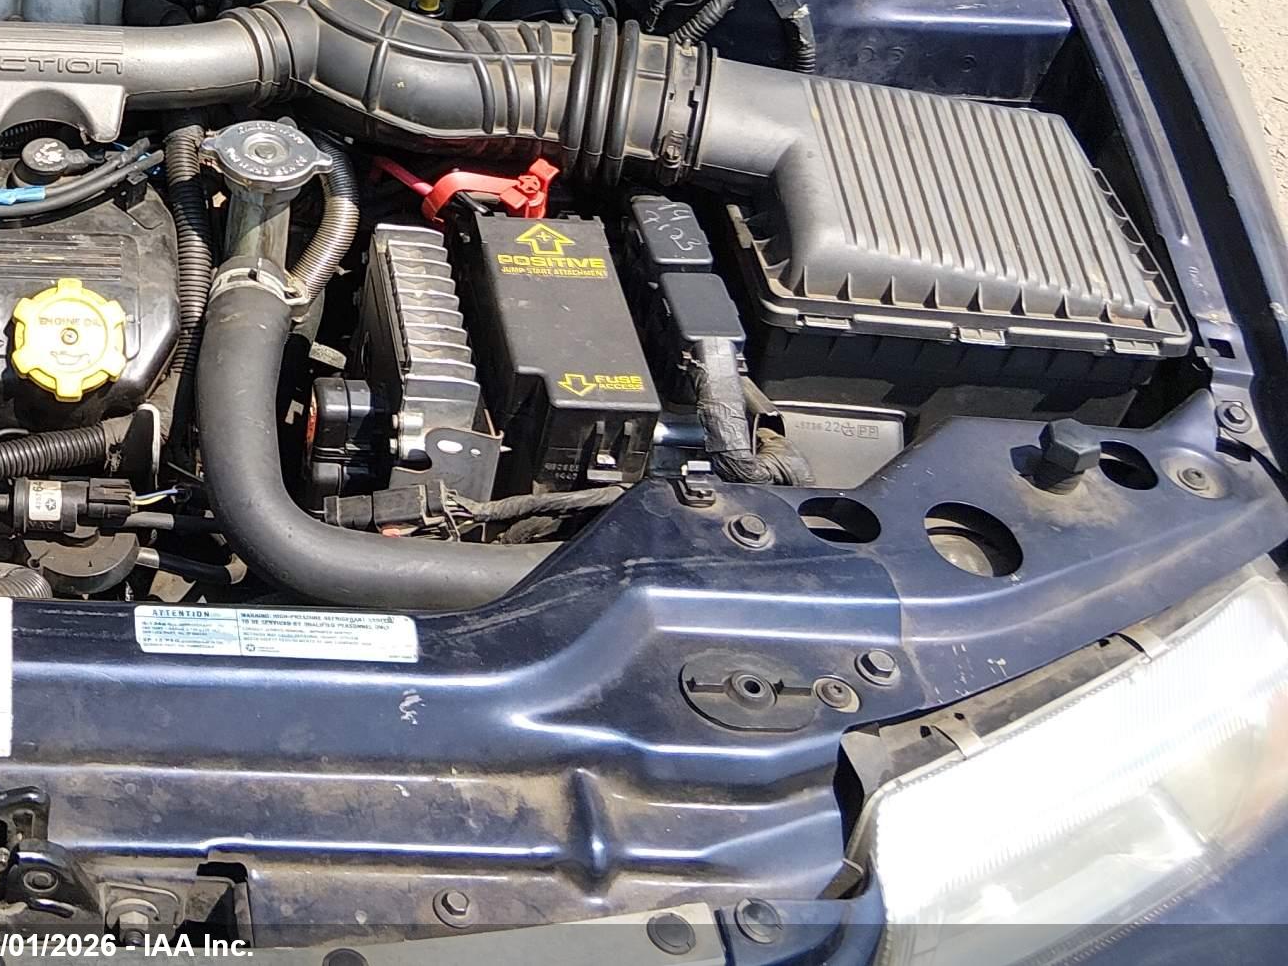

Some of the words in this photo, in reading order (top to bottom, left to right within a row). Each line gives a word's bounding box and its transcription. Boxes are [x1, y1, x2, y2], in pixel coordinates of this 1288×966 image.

[497, 254, 607, 269] POSITIVE
[594, 375, 642, 384] FUSE
[152, 609, 210, 618] ATTENTION
